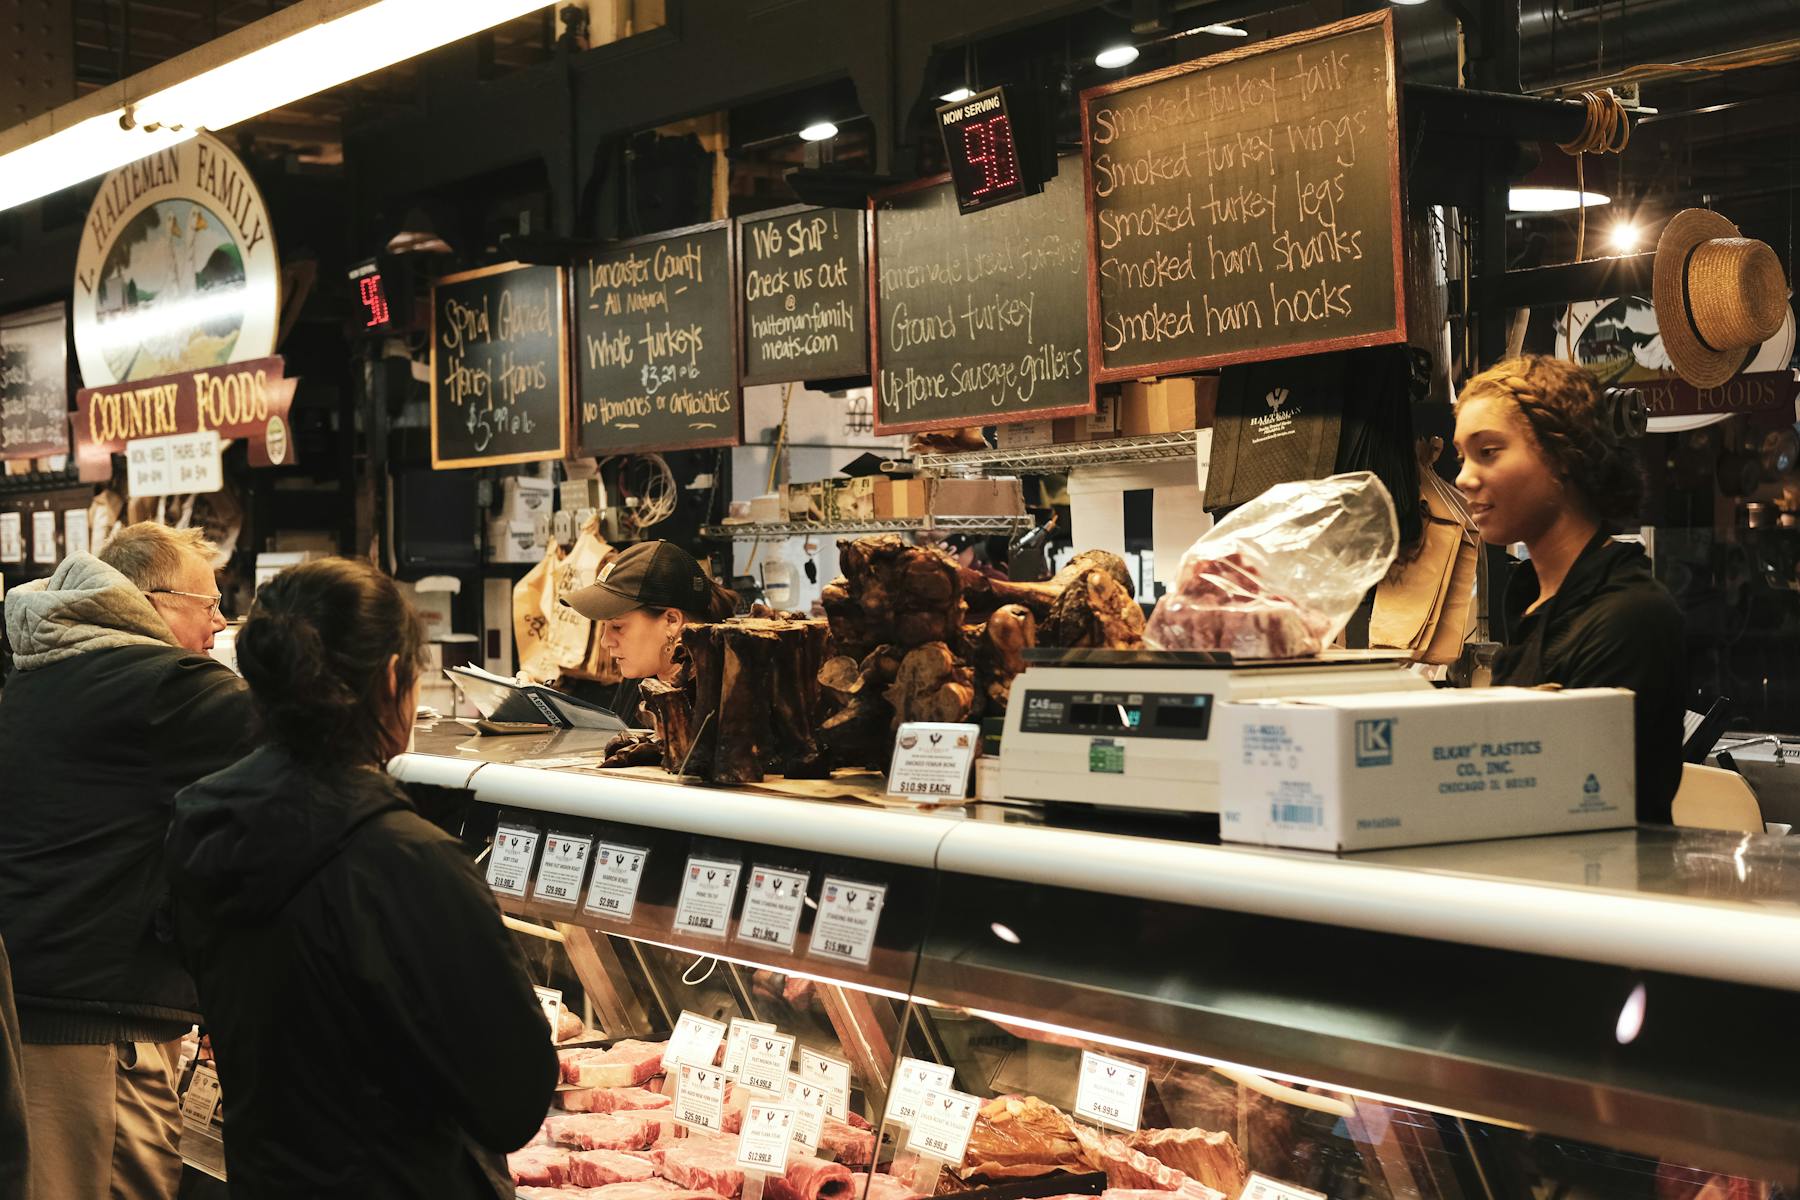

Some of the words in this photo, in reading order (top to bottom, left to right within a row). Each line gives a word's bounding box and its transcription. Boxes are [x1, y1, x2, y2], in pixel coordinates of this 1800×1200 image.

[943, 109, 963, 125] NOW
[964, 95, 1000, 120] SERVING
[1094, 86, 1195, 144] Smoked
[1197, 67, 1279, 122] turkey
[964, 115, 1015, 196] 90
[1095, 141, 1192, 197] Smoked
[1197, 129, 1275, 176] turkey
[1287, 114, 1366, 168] wings
[91, 146, 179, 254] HALTEMAN
[197, 142, 264, 257] FAMILY
[1099, 193, 1196, 249] Smoked
[1200, 184, 1276, 234] turkey
[1296, 170, 1344, 228] legs
[753, 221, 782, 260] We
[1100, 242, 1196, 287] Smoked
[1208, 235, 1262, 279] ham
[588, 252, 651, 298] Lancaster
[654, 242, 702, 282] County
[746, 266, 790, 301] Check
[794, 268, 813, 289] us
[818, 257, 848, 288] out
[604, 292, 622, 316] All
[627, 283, 669, 314] Natural
[785, 294, 797, 312] @
[890, 302, 956, 352] Ground
[961, 291, 1035, 344] turkey
[1104, 300, 1194, 352] Smoked
[1204, 294, 1262, 336] ham
[1270, 279, 1352, 325] hocks
[587, 328, 634, 369] Whole
[638, 322, 703, 366] turkeys
[499, 351, 546, 405] Hams
[951, 357, 1016, 407] Sausage
[1017, 343, 1083, 401] grillers
[1696, 379, 1776, 411] FOODS
[89, 383, 178, 446] COUNTRY
[194, 369, 268, 433] FOODS
[583, 402, 598, 424] No
[656, 395, 667, 411] or
[670, 388, 731, 417] antibiotics
[1481, 741, 1542, 757] PLASTICS
[900, 780, 928, 794] $10.99
[929, 782, 952, 795] EACH
